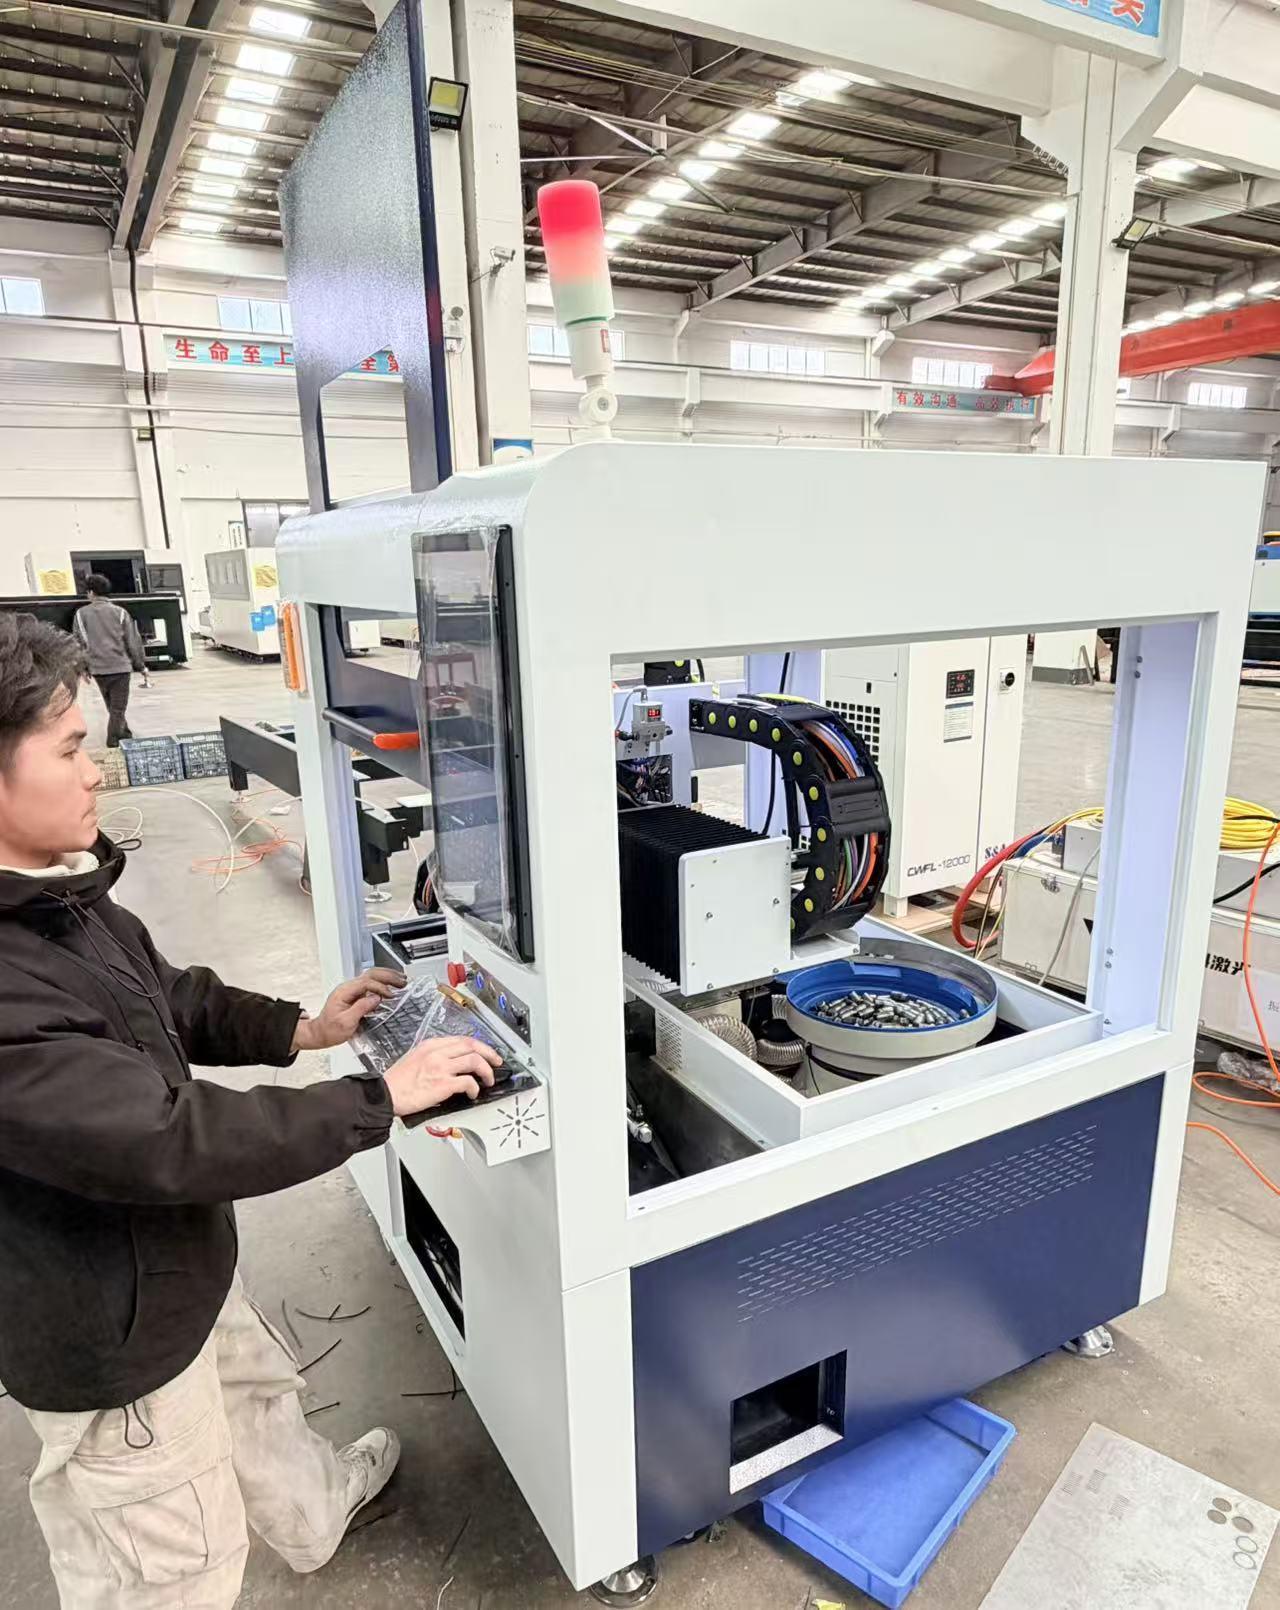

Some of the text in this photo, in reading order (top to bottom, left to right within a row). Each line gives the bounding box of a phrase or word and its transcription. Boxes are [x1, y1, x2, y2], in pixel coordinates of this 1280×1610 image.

[175, 338, 295, 366] 生命至上
[896, 391, 957, 408] 有效沟通
[1205, 953, 1251, 976] 激光
